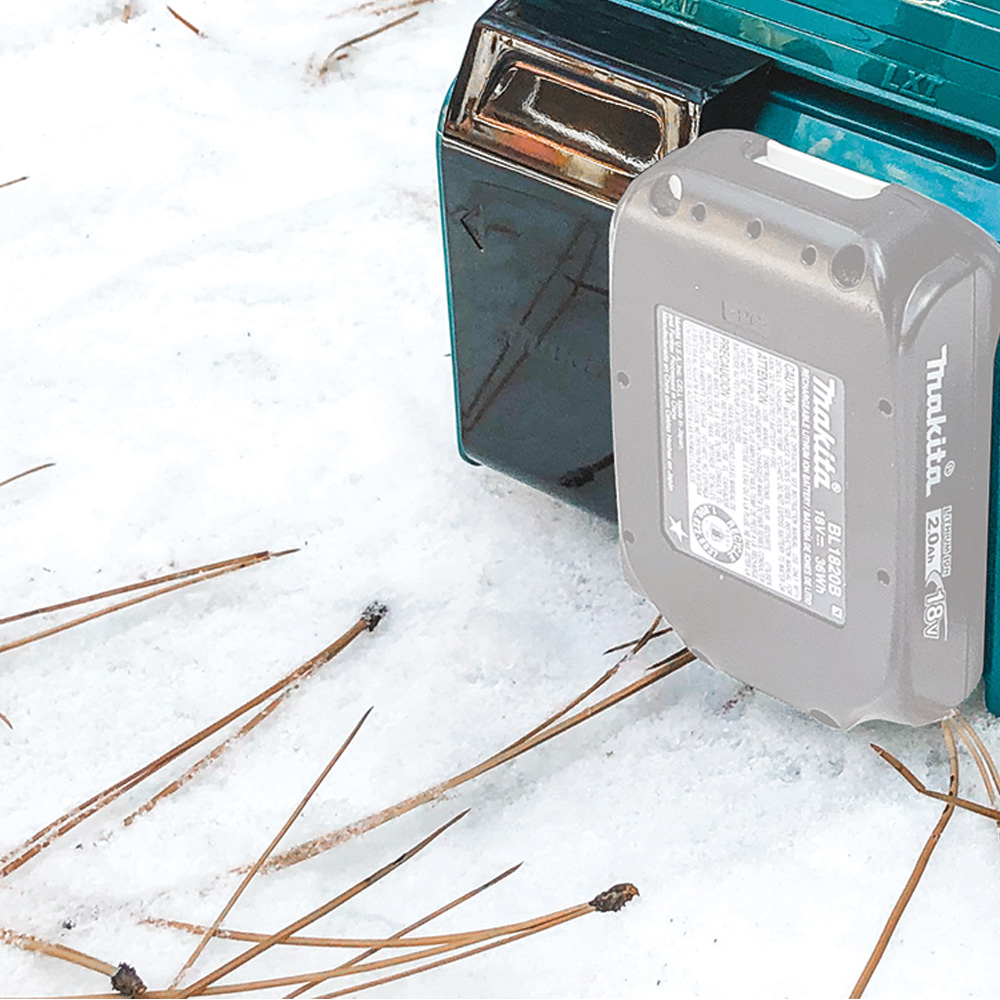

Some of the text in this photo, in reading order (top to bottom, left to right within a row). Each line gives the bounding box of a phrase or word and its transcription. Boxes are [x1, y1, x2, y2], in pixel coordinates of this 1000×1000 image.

[826, 519, 841, 599] BL1820B
[927, 516, 940, 564] 2.0Ah
[814, 554, 825, 596] 36Wh
